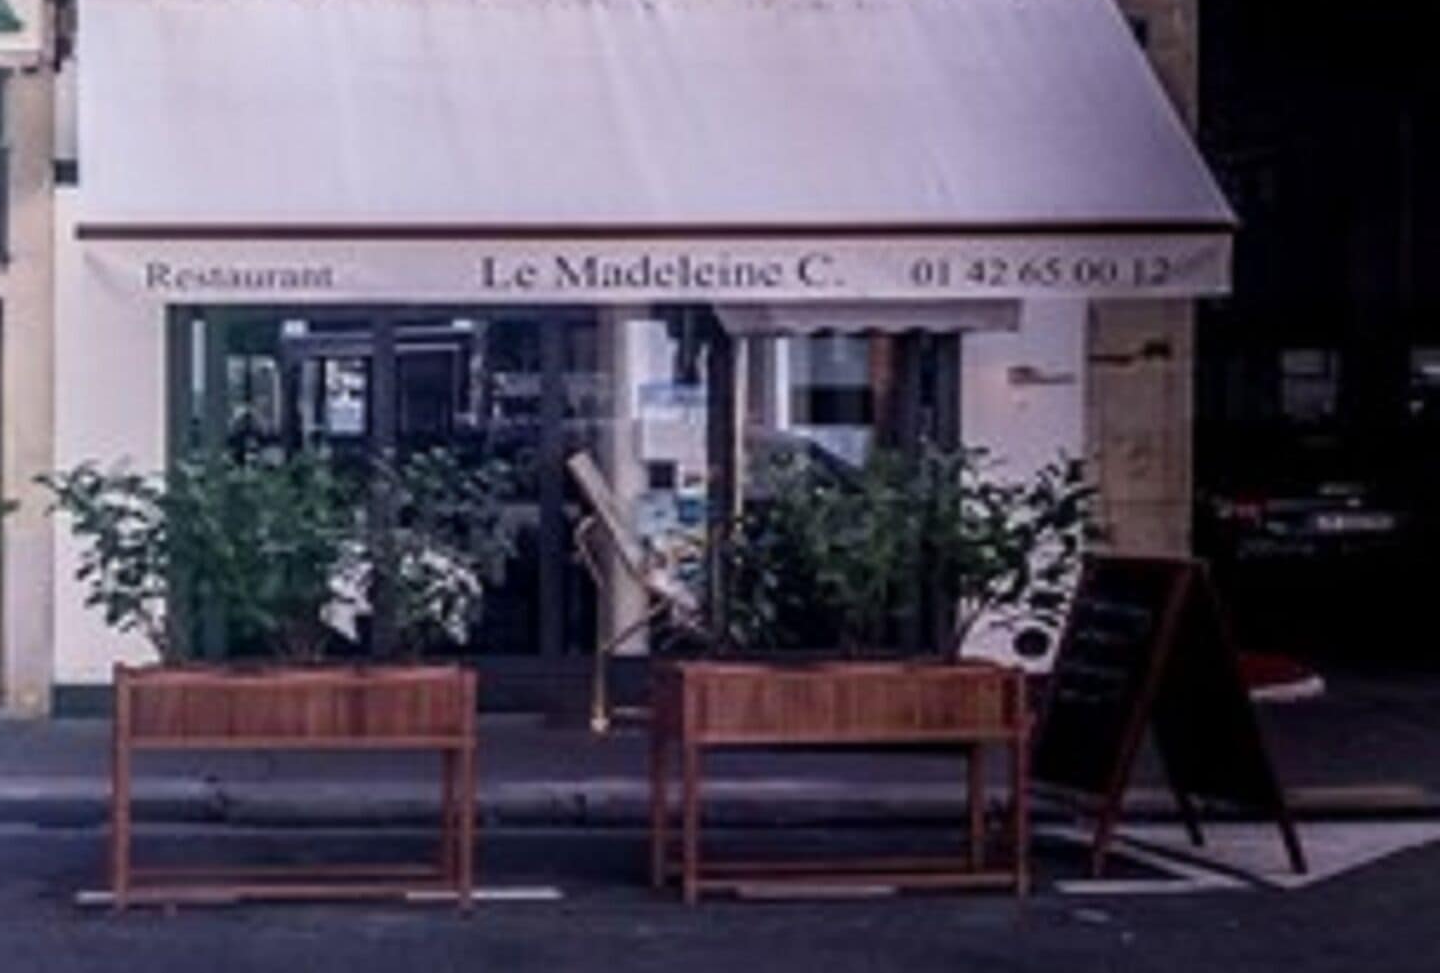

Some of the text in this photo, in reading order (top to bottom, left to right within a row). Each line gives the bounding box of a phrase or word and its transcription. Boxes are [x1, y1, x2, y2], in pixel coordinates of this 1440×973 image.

[144, 252, 1172, 290] Restaurant Le Madeleine C. 01 42 65 00 12
